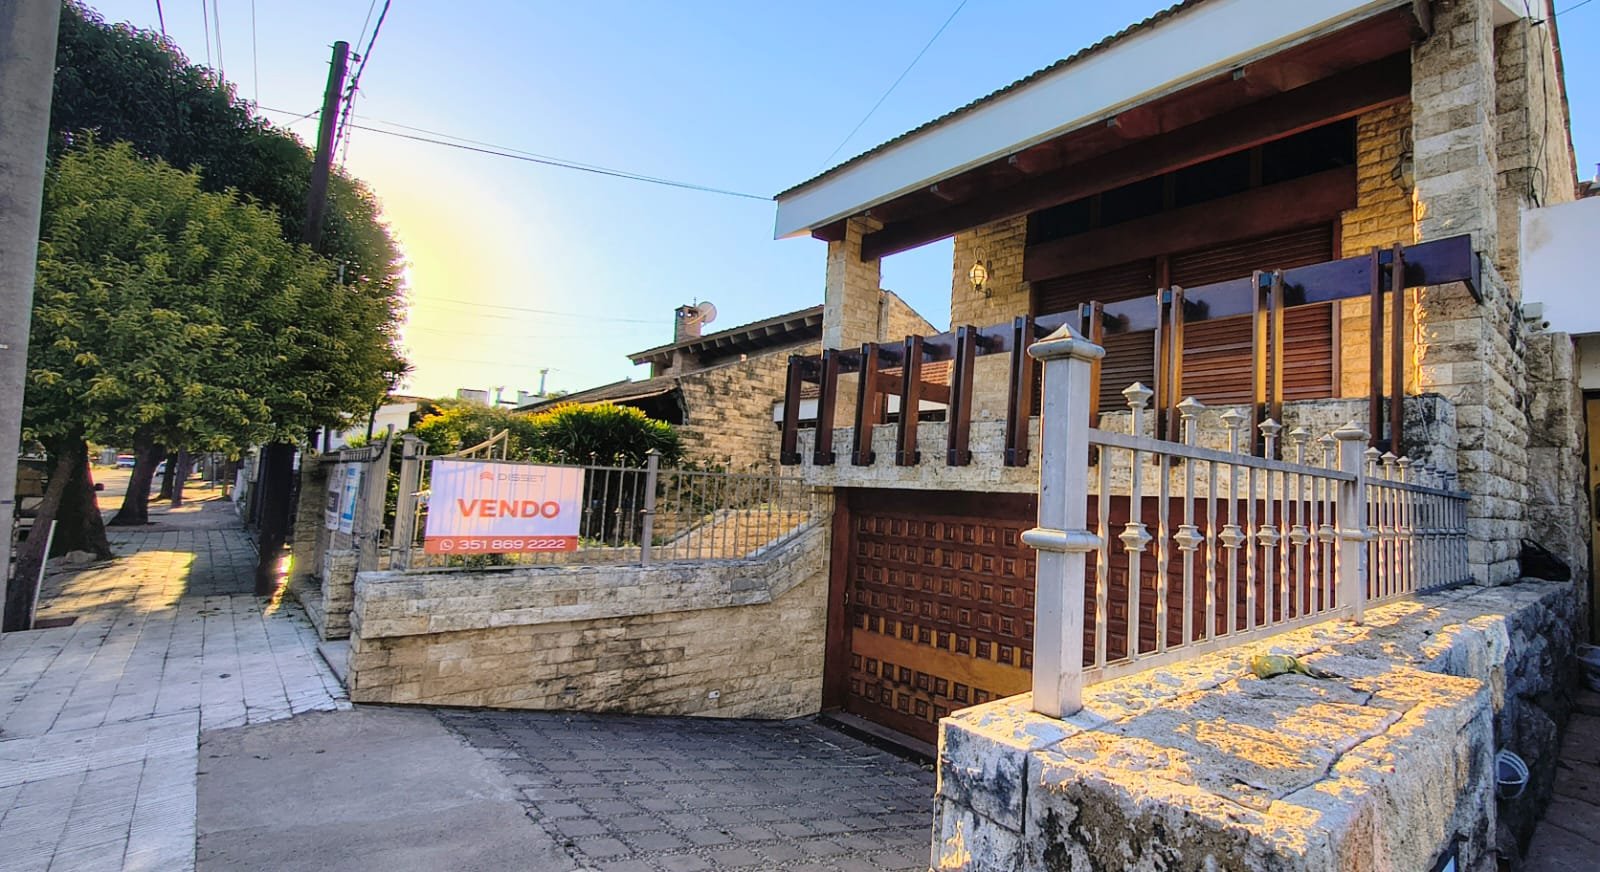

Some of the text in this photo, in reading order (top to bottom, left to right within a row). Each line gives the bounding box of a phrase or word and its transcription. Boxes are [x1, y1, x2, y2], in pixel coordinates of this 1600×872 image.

[457, 498, 561, 519] VENDO
[458, 539, 566, 550] 351 869 2222
